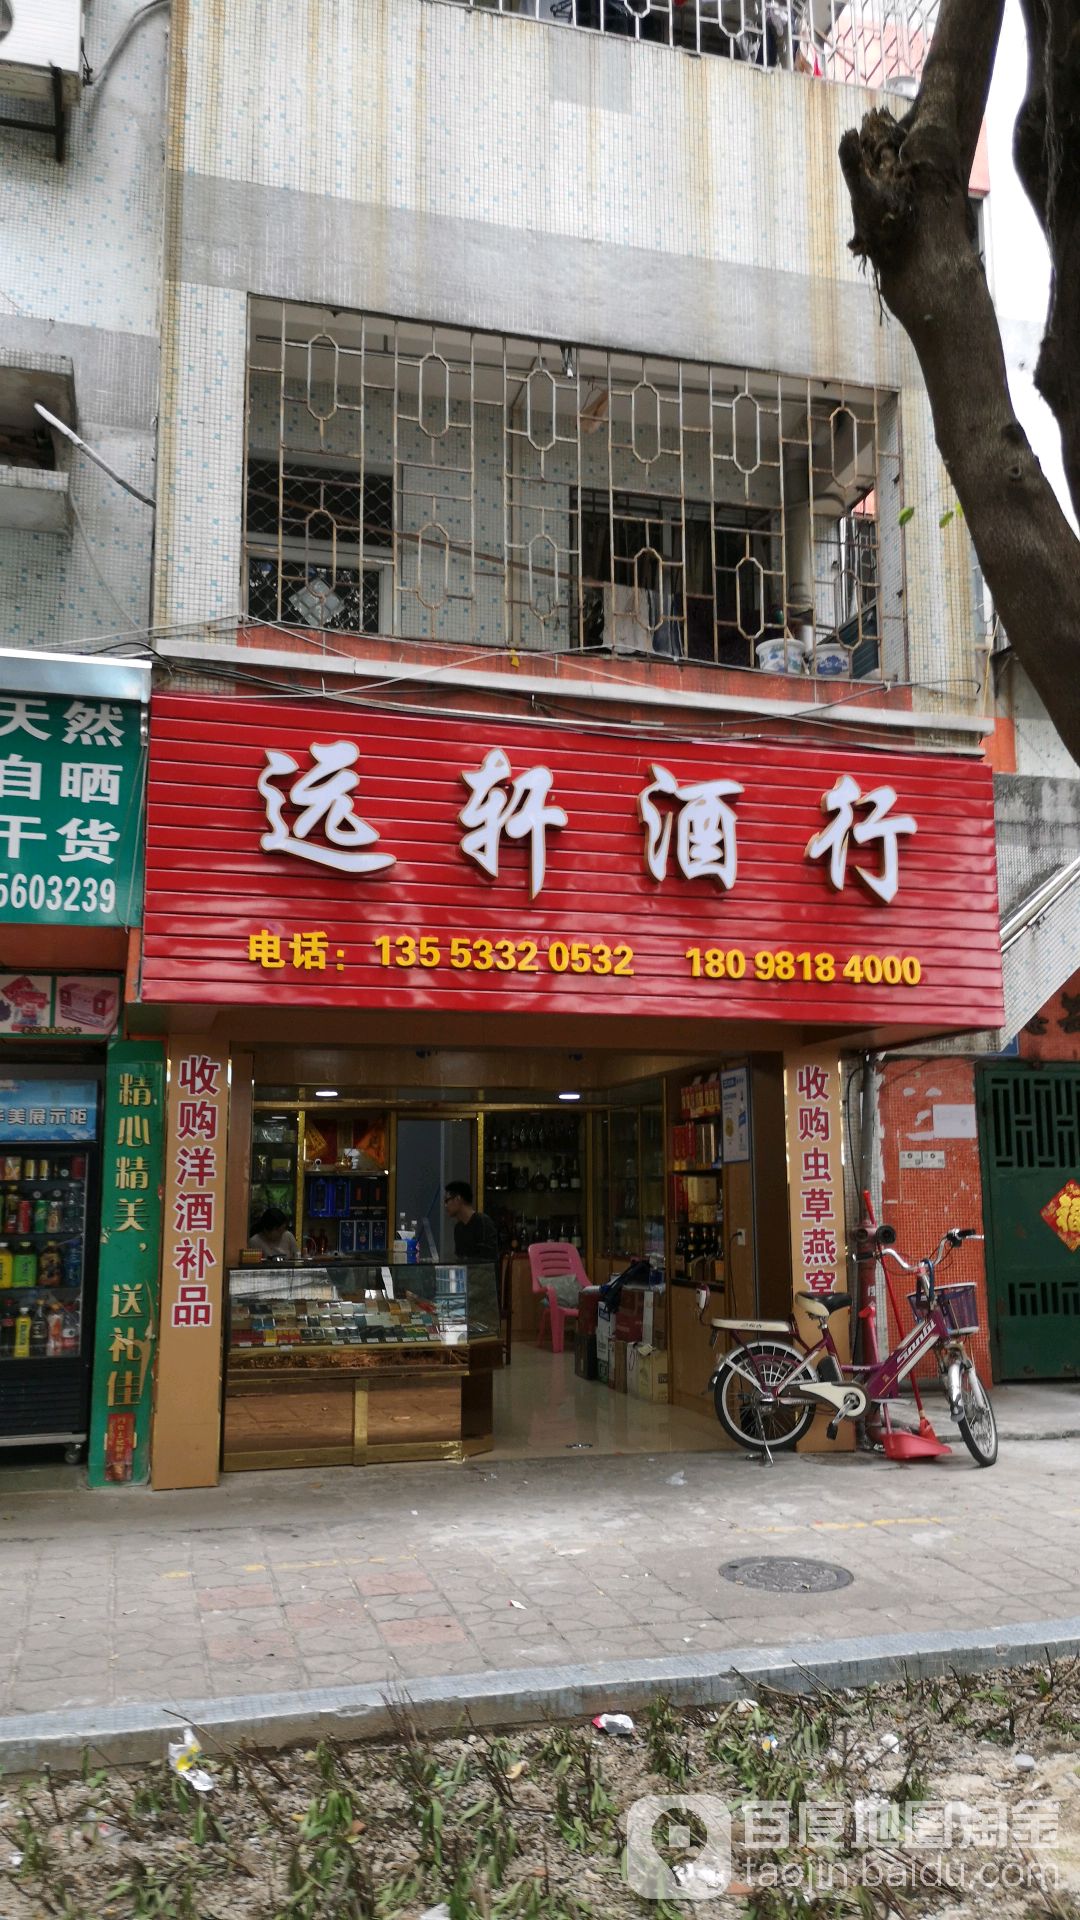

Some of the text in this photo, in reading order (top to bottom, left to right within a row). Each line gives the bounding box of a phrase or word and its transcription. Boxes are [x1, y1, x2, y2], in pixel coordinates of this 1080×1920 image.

[0, 696, 126, 748] 天然
[0, 753, 124, 806] 自晒
[0, 813, 121, 865] 干货
[258, 740, 918, 903] 远轩酒行
[374, 935, 441, 968] 135
[450, 938, 539, 972] 5332
[548, 941, 634, 976] 0532
[686, 946, 746, 979] 180
[754, 951, 836, 982] 9818
[843, 954, 922, 985] 4000
[0, 1107, 88, 1125] 美展示柜
[172, 1055, 221, 1327] 收购洋酒补品
